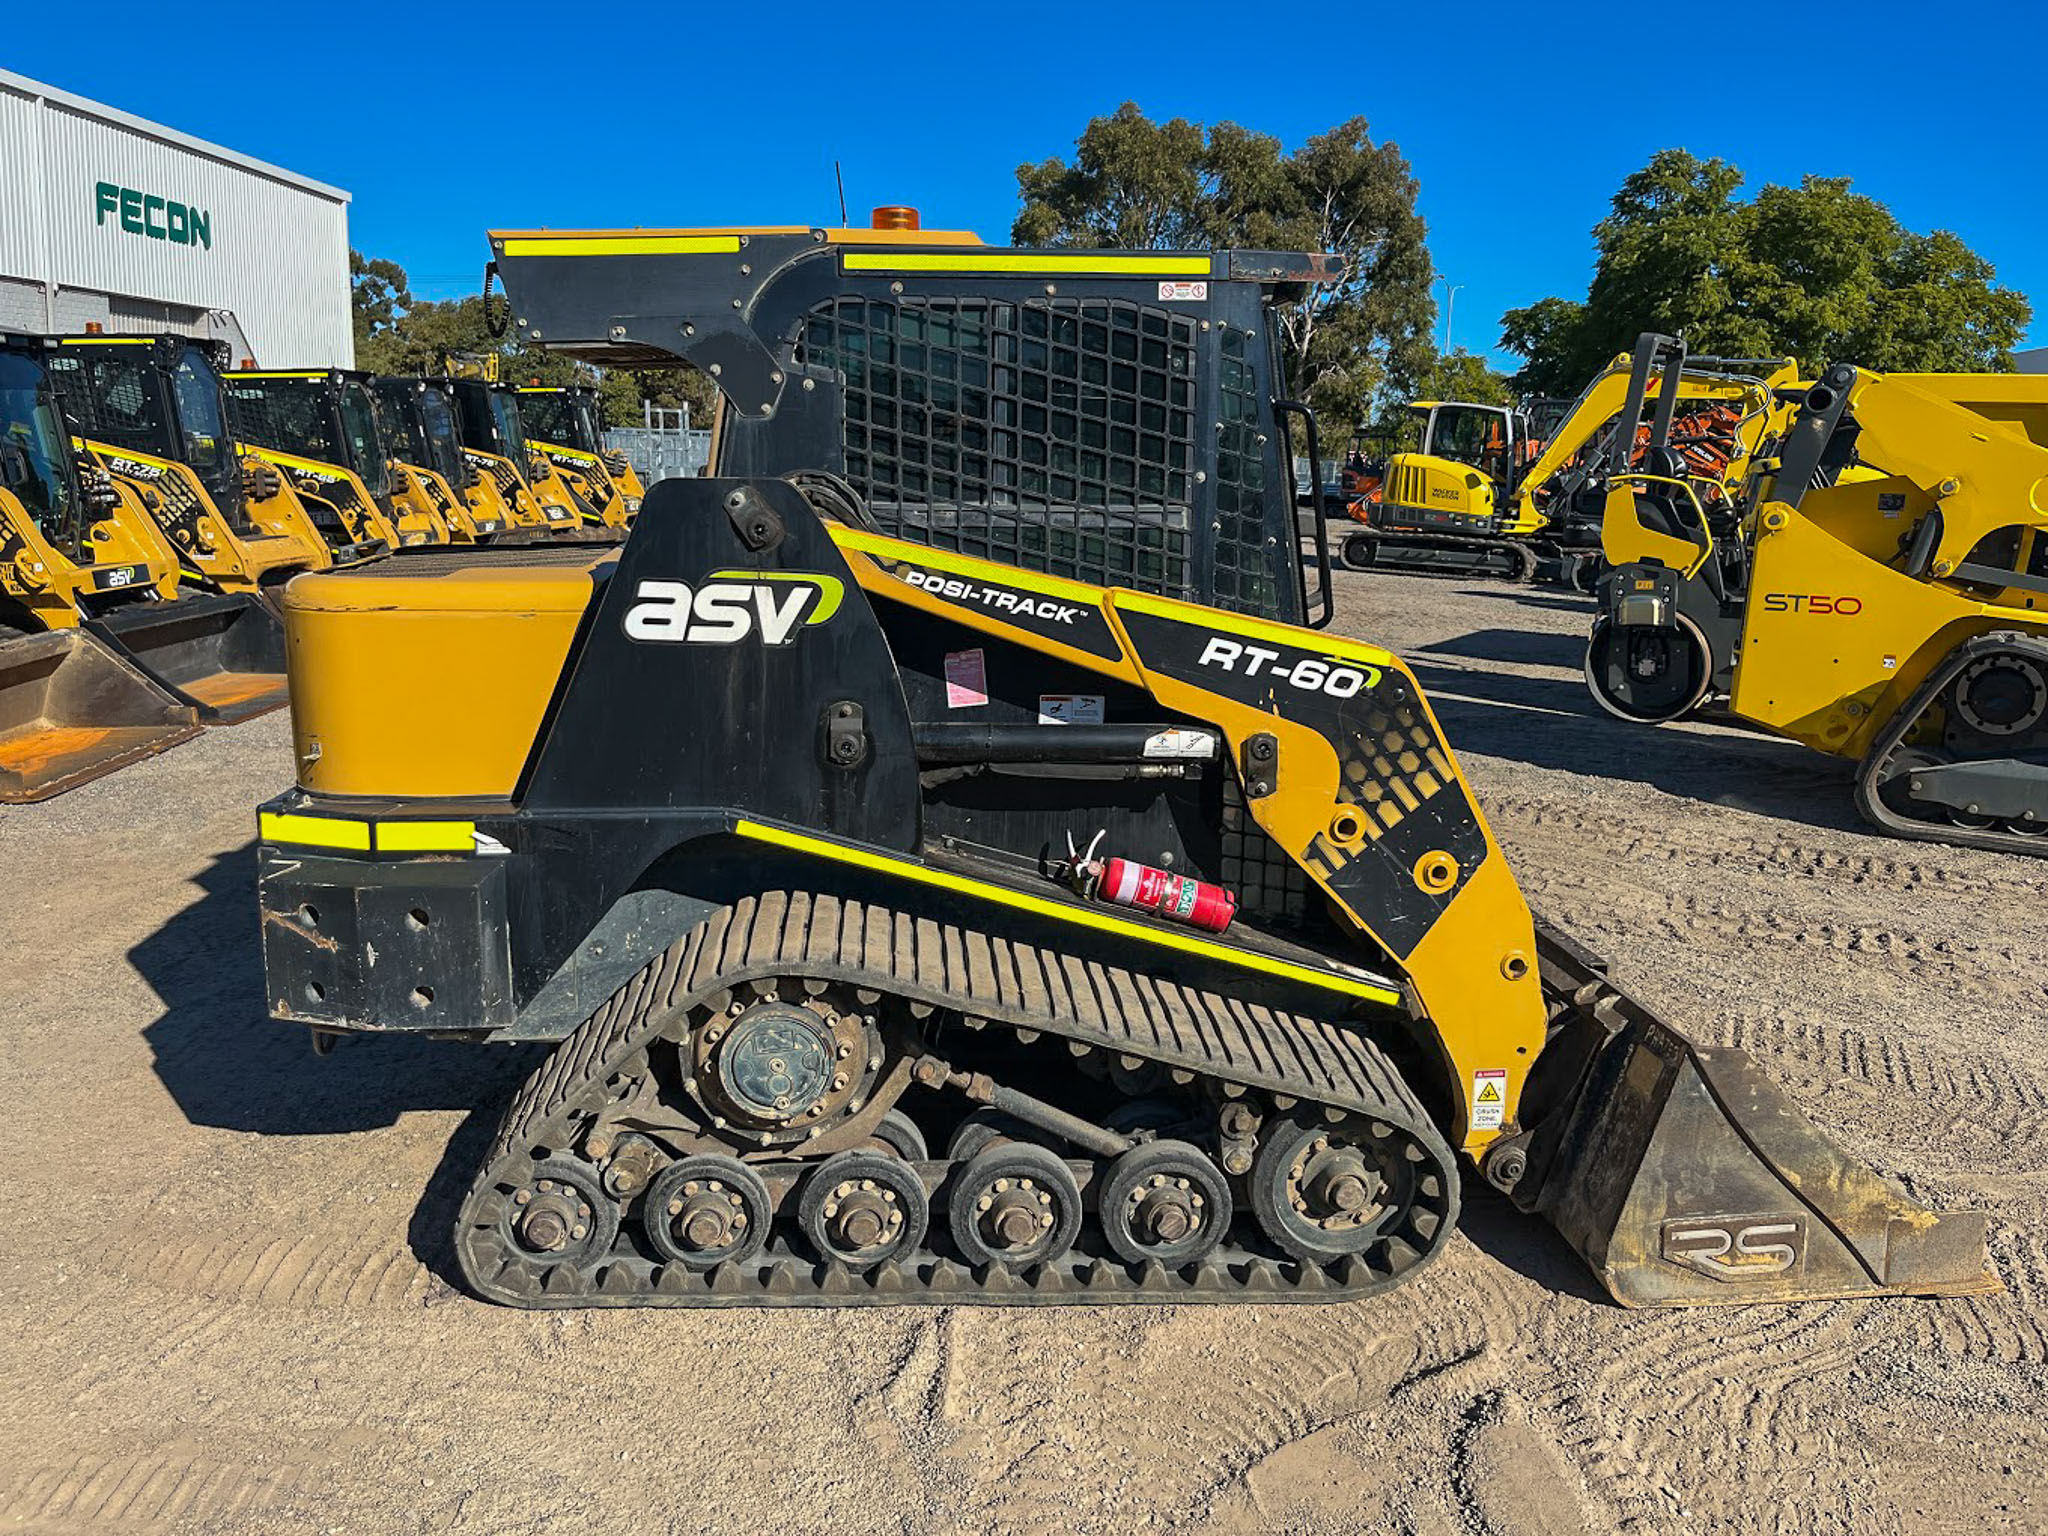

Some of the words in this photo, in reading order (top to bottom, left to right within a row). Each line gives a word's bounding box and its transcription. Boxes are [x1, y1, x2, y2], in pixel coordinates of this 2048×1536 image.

[96, 181, 211, 251] FECON
[904, 570, 1079, 625] POSI-TRACK
[1764, 593, 1862, 616] ST50
[1197, 636, 1365, 699] RT-60
[1671, 1223, 1797, 1275] RS
